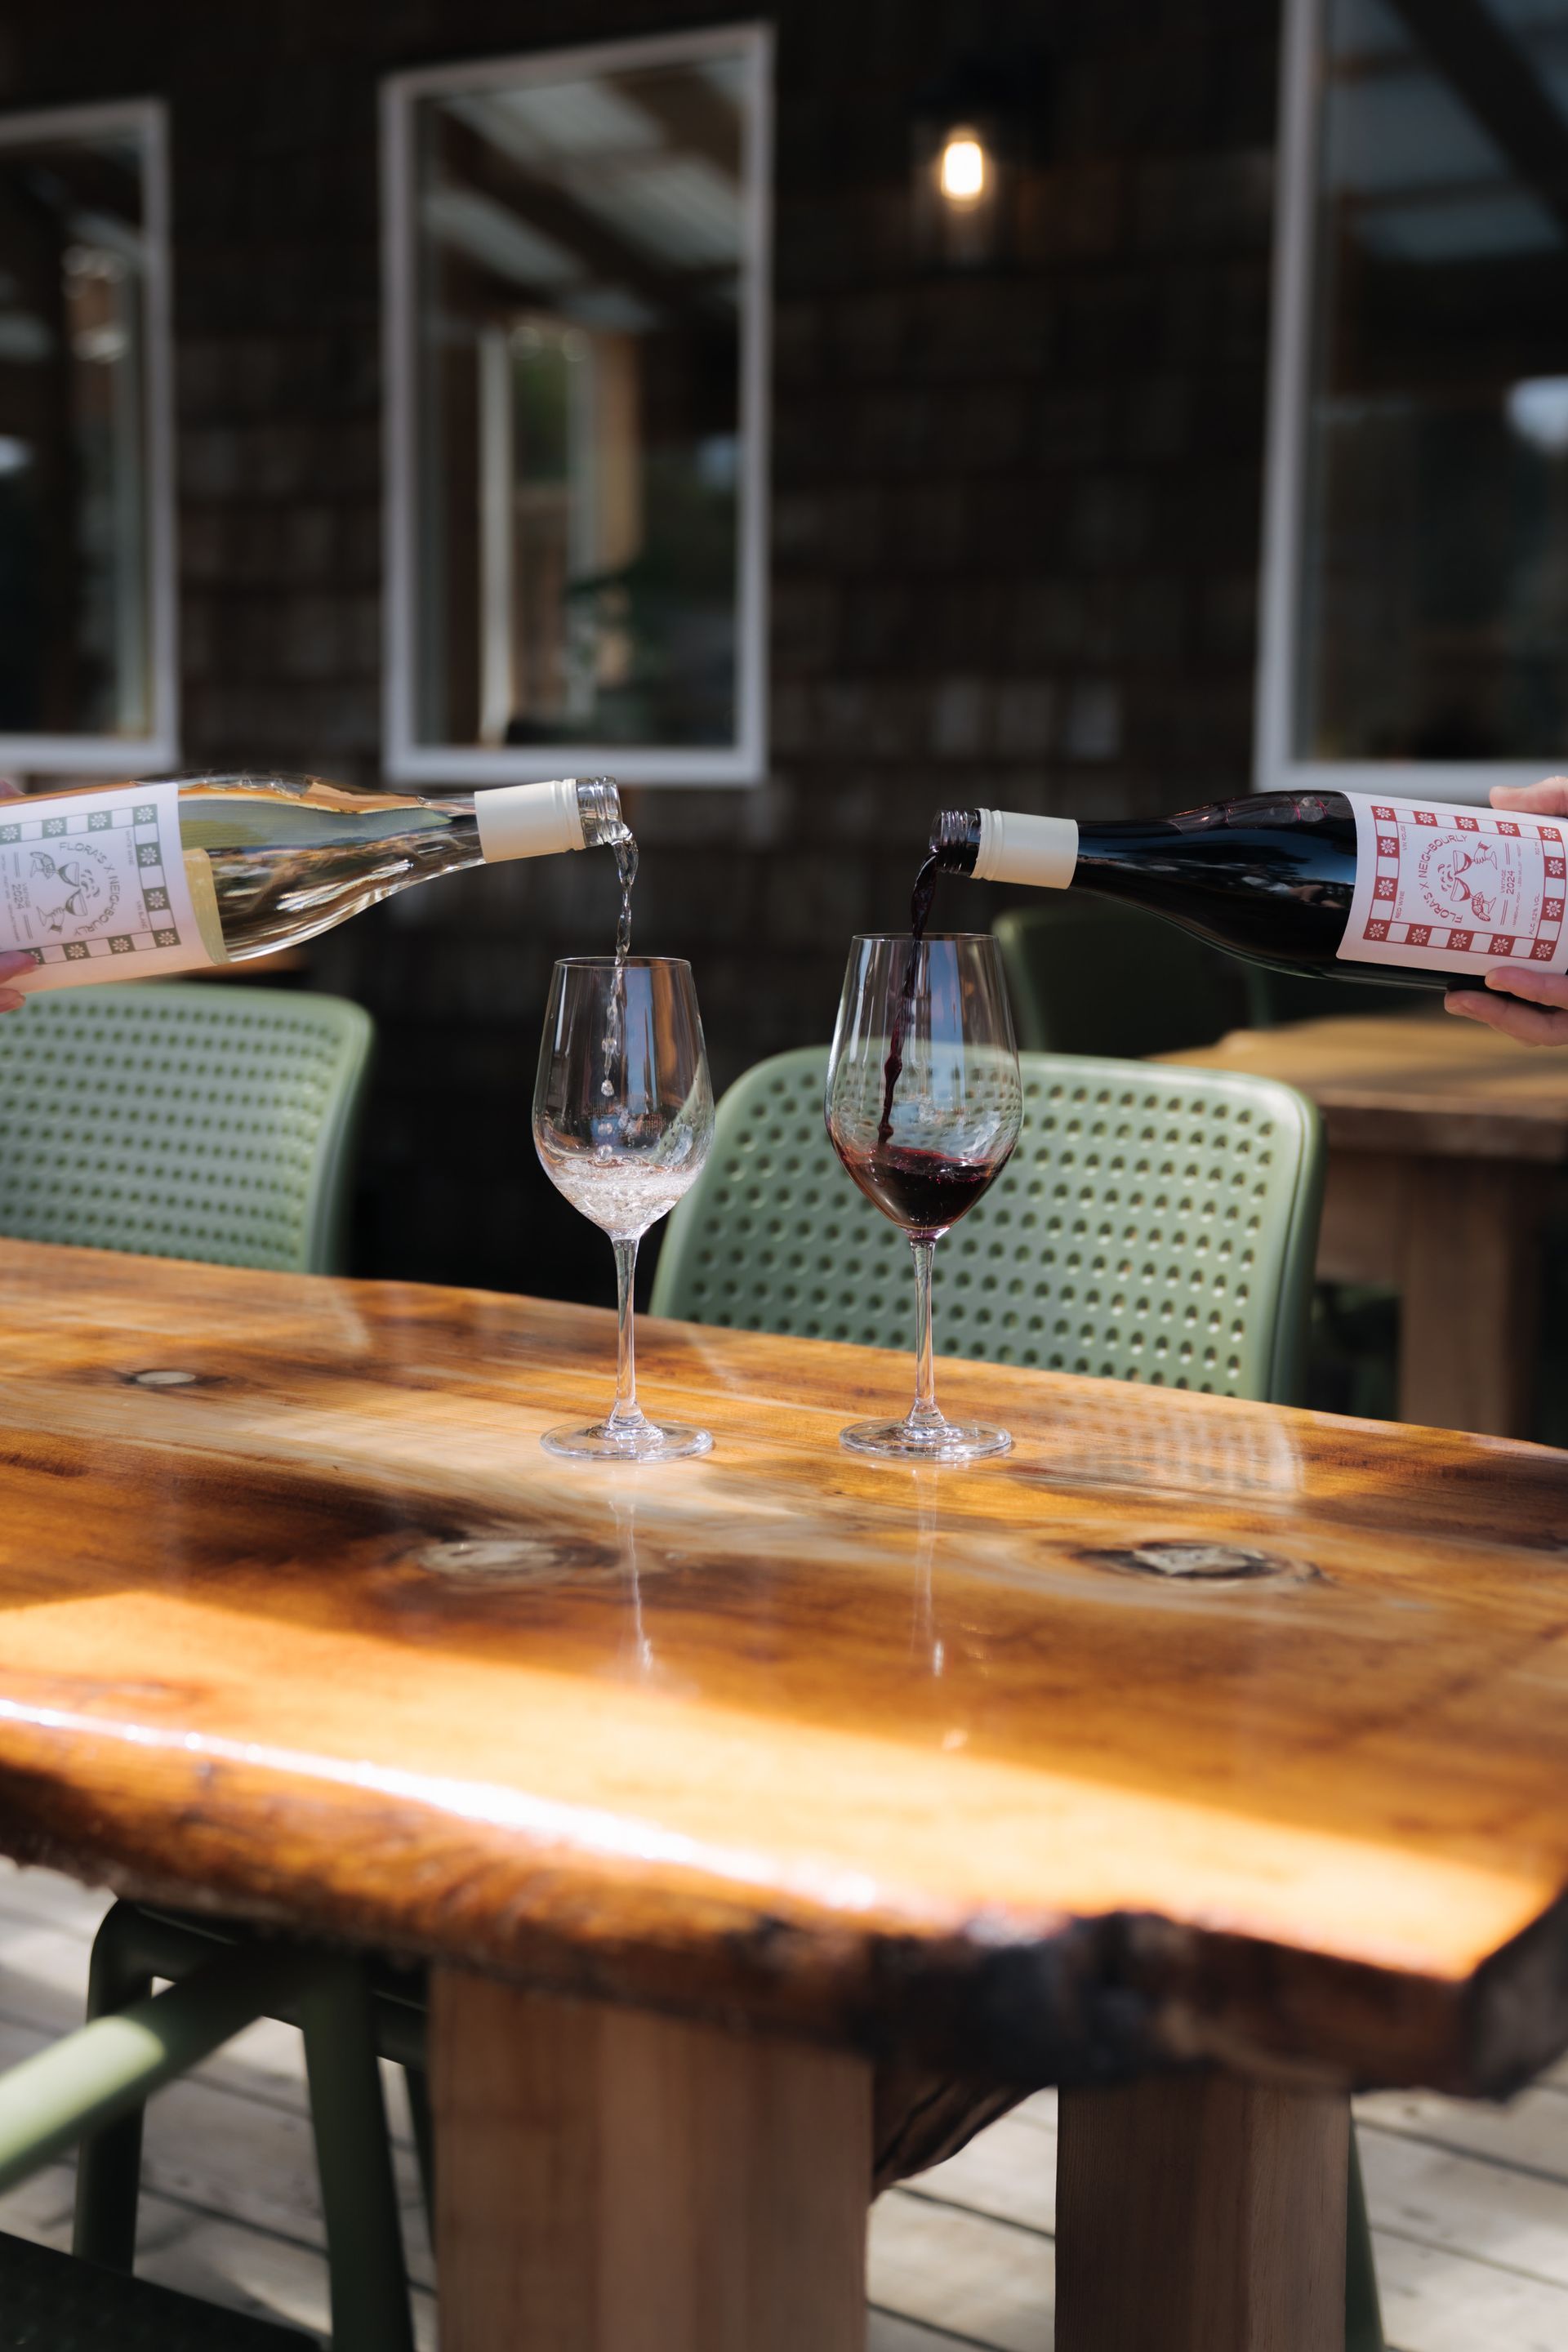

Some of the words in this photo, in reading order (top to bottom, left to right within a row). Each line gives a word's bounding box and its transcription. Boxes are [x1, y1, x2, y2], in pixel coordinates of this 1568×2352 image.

[59, 842, 107, 864] FLORA'S
[1418, 835, 1468, 878] NEIGHBOURLY
[104, 865, 115, 874] X
[1419, 882, 1429, 890] X
[1506, 870, 1516, 895] 2024
[11, 884, 24, 910] 2024
[74, 875, 120, 936] NEIGHBOURLY
[1423, 892, 1463, 924] FLORA'S
